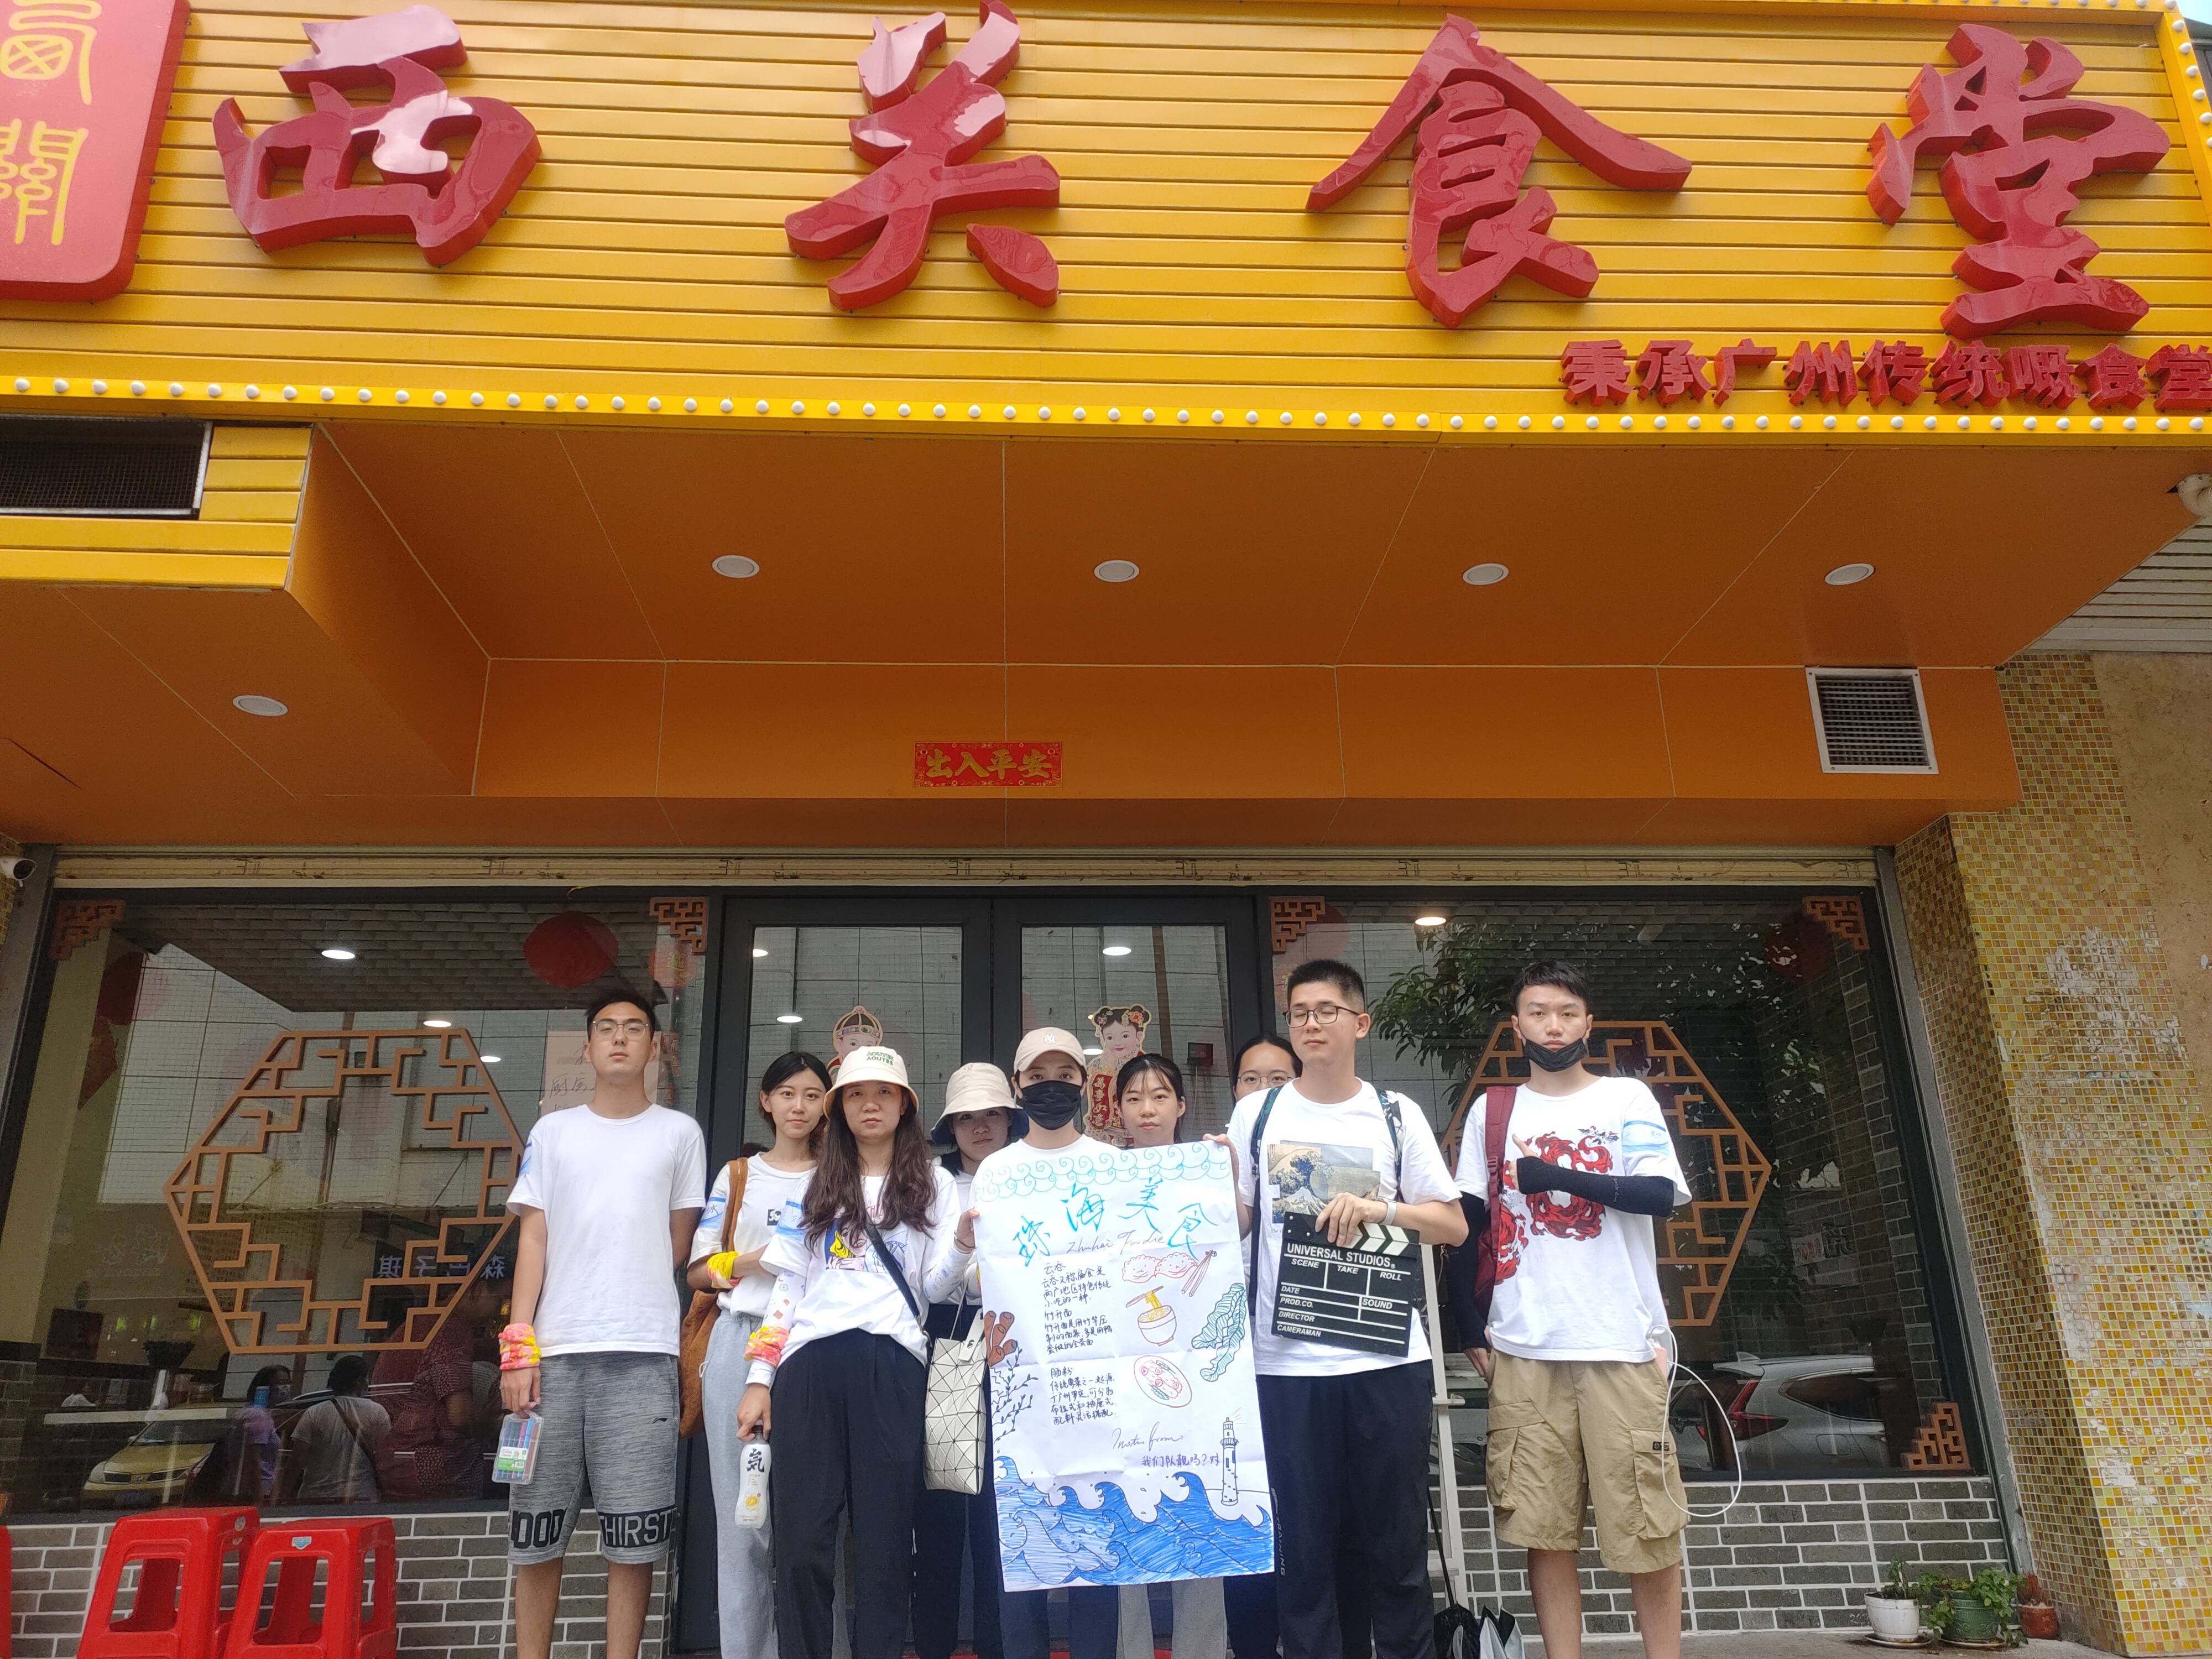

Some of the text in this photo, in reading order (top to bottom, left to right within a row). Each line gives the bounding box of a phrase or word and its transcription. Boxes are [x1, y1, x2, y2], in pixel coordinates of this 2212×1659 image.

[1561, 338, 2212, 411] 秉承广州传统嘅食堂
[926, 748, 1053, 780] 出入平安
[1287, 1243, 1343, 1261] UNIVERSAL
[1044, 1261, 1066, 1275] 云吞
[1291, 1258, 1402, 1281] SCENE TAKE ROLL
[1281, 1286, 1300, 1294] DATE
[1280, 1297, 1313, 1308] PROD.CO.
[1362, 1298, 1392, 1310] SOUND
[1279, 1311, 1315, 1322] DIRECTOR
[1277, 1324, 1321, 1337] CAMERAMAN
[1051, 1366, 1073, 1379] 肠粉
